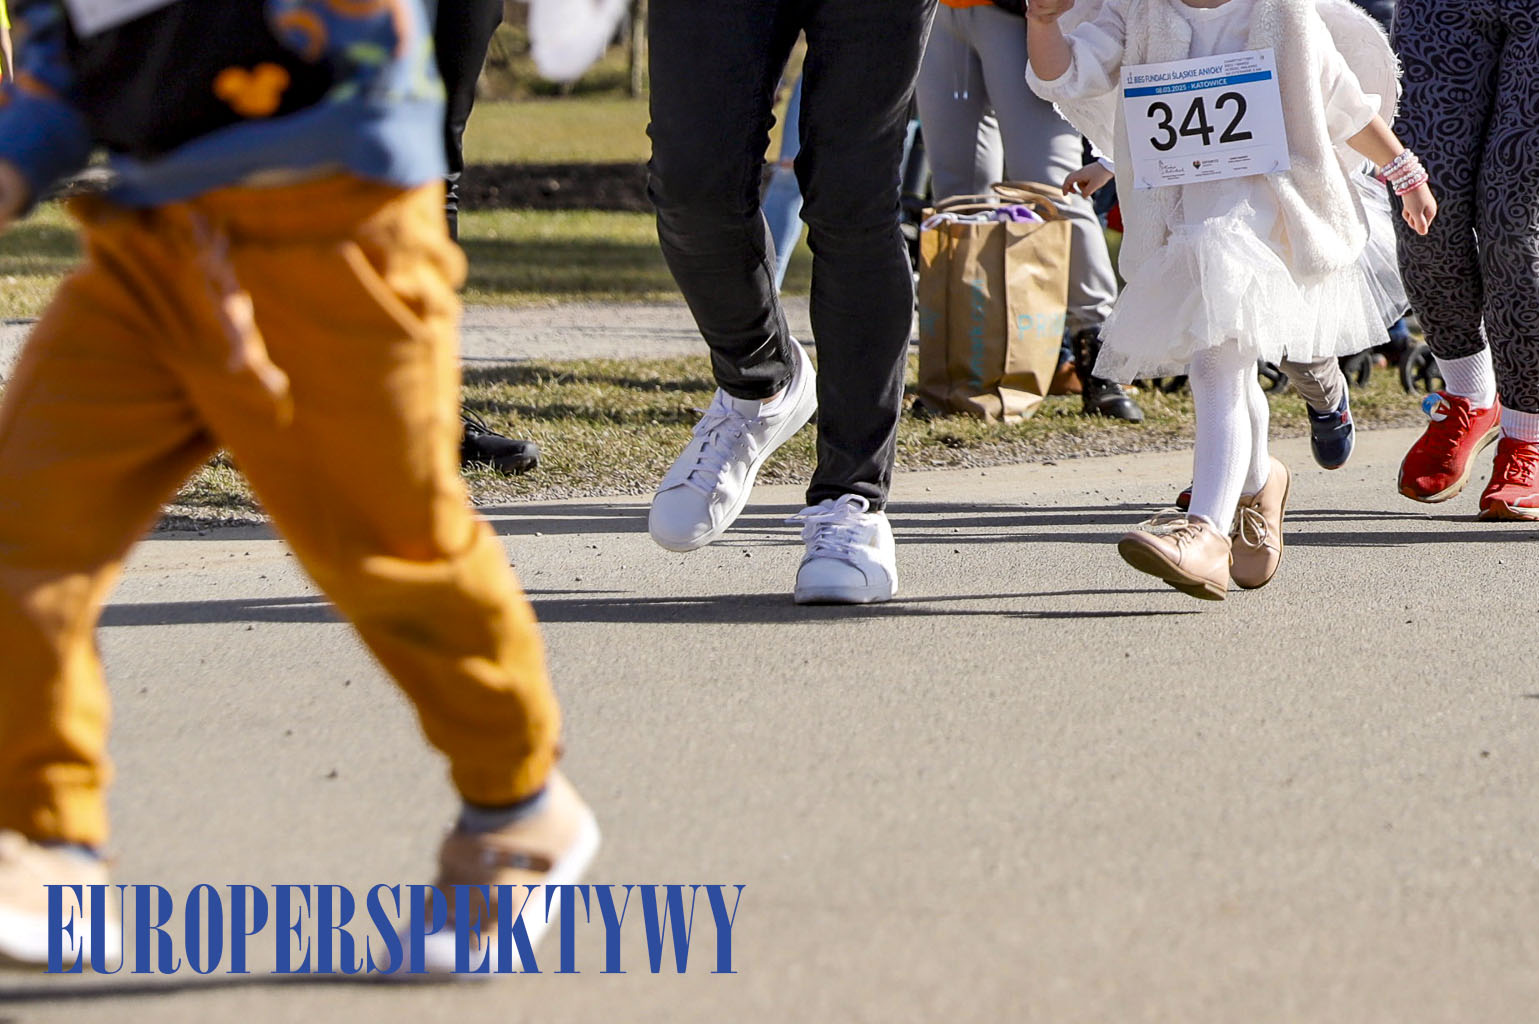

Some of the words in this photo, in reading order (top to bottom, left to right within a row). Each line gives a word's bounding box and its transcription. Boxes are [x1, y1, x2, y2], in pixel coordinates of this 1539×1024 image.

[1145, 74, 1171, 83] FUNDACJI
[1172, 68, 1197, 80] ŚLĄSKIE
[1198, 65, 1223, 76] ANIOŁY
[1190, 78, 1228, 89] KATOWICE
[1147, 91, 1253, 151] 342
